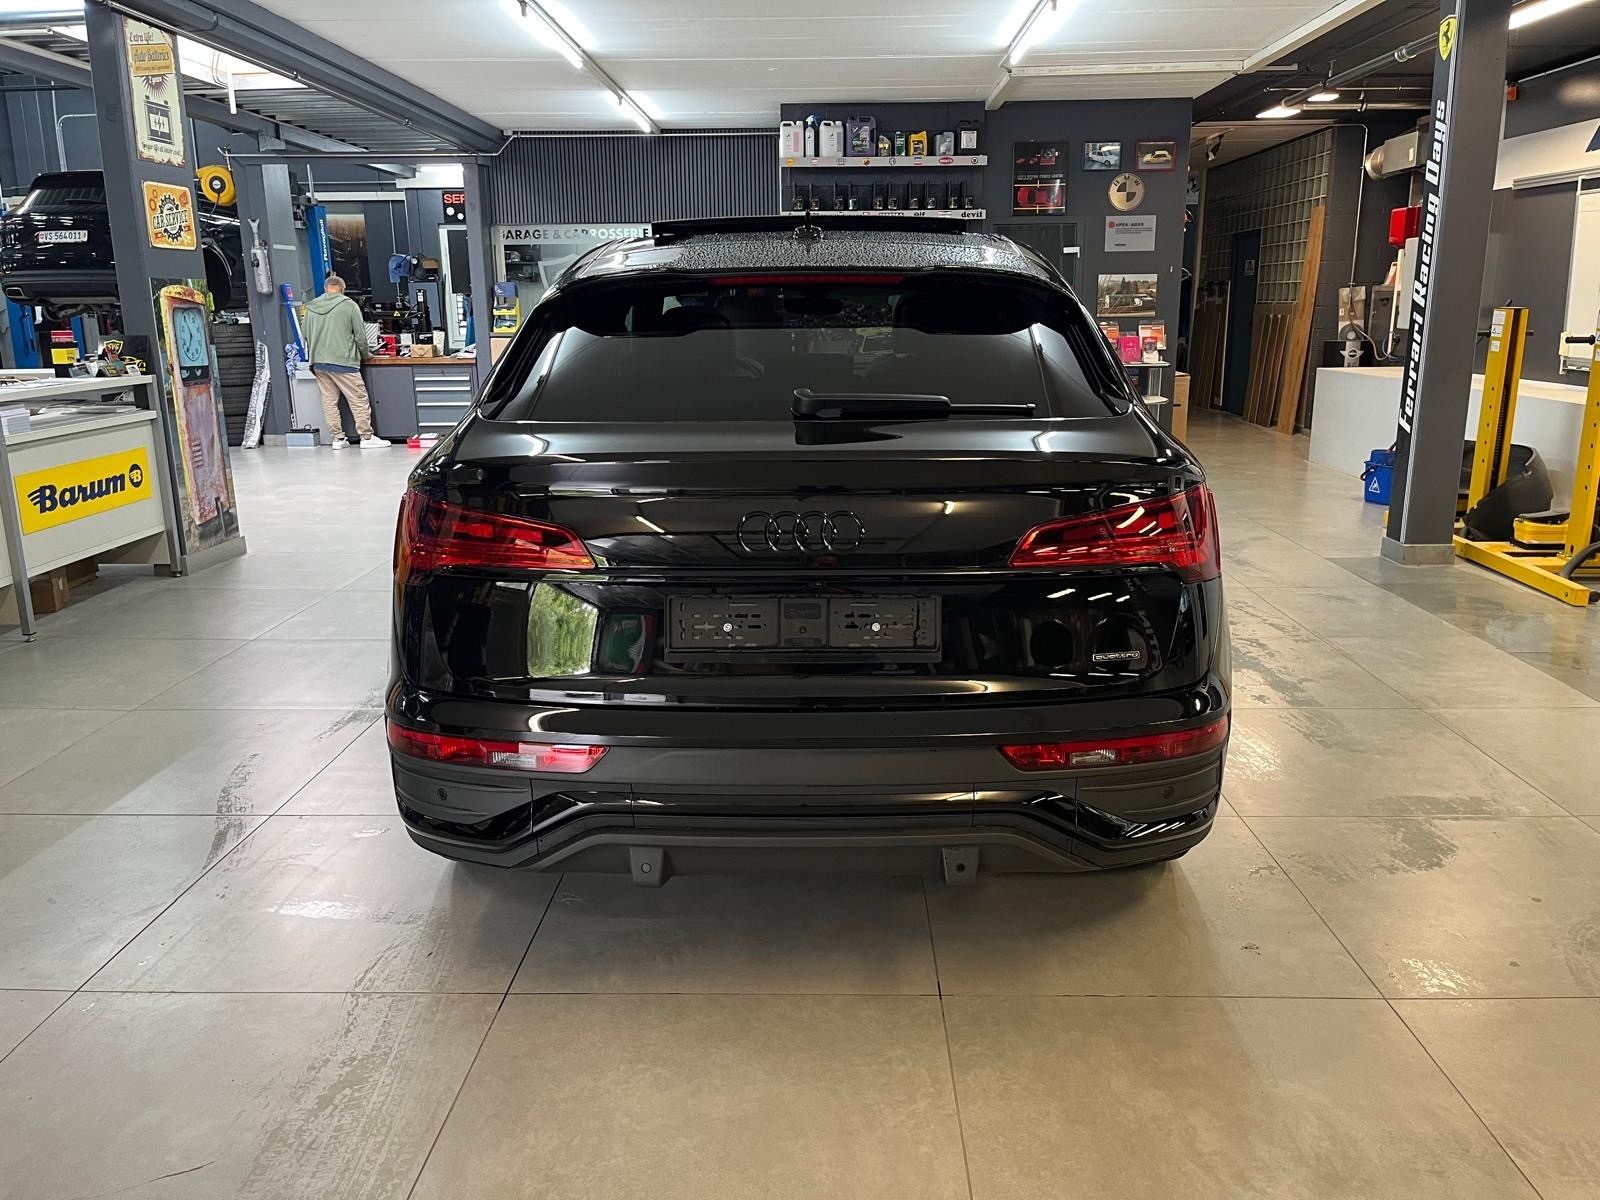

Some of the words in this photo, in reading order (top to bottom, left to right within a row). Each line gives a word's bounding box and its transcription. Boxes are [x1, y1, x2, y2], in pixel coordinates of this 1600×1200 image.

[1425, 99, 1447, 186] Days
[54, 232, 81, 240] 564011
[153, 214, 165, 229] CAR
[165, 209, 188, 228] SERVICE
[1413, 193, 1440, 308] Racing
[1399, 311, 1423, 434] Ferrari
[28, 473, 125, 514] Barum
